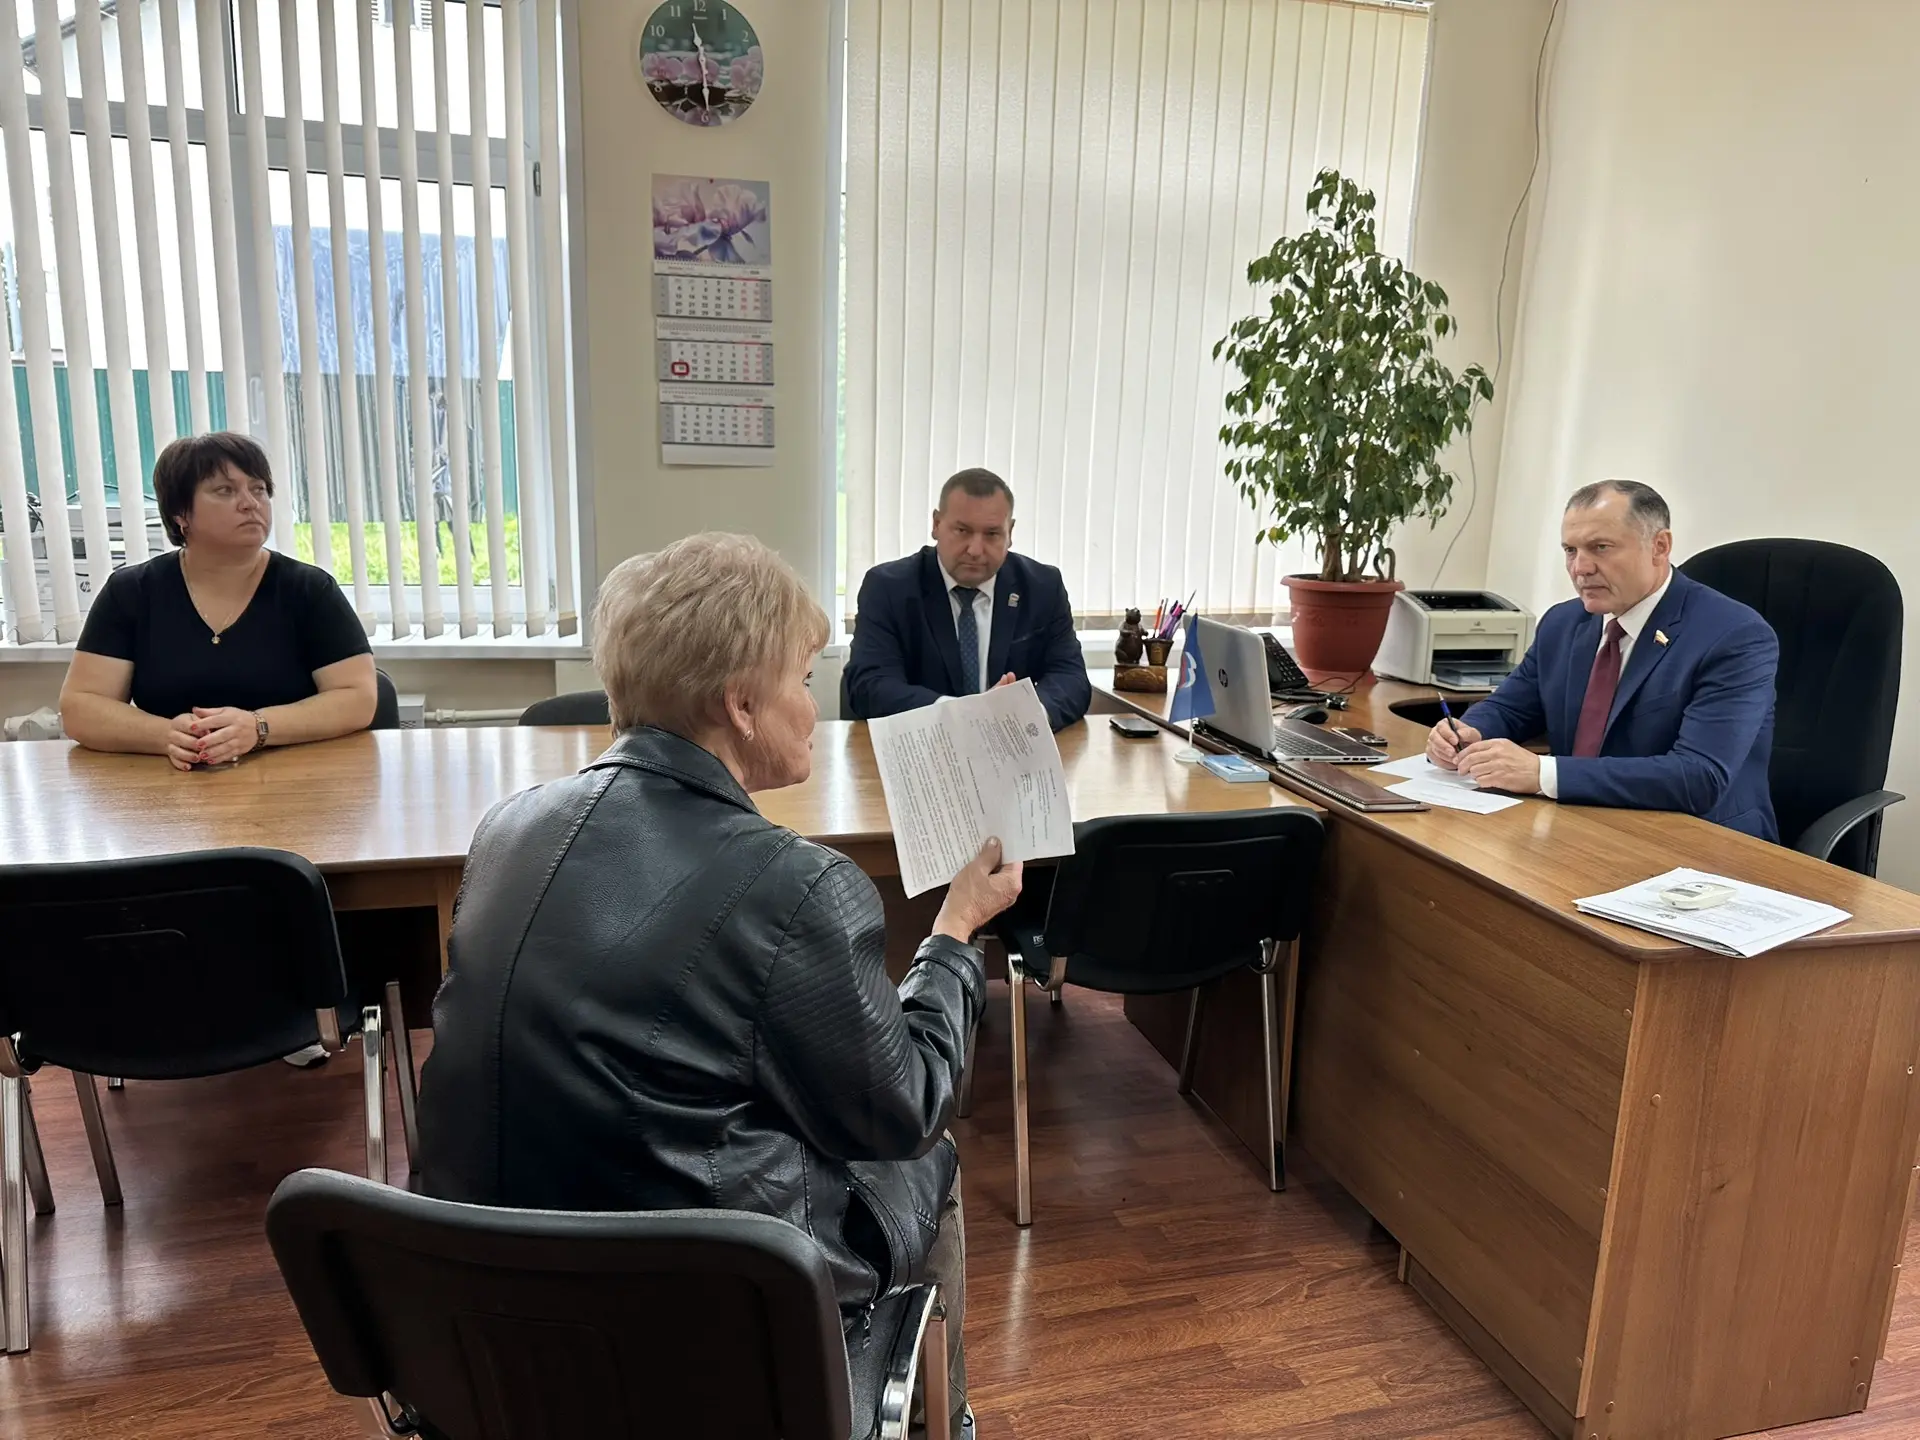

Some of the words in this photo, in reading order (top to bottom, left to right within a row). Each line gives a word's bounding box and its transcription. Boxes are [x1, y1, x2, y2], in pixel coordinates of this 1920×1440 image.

[670, 5, 681, 17] 11
[692, 0, 707, 12] 12
[722, 8, 727, 20] 1
[650, 24, 665, 37] 10
[742, 31, 749, 42] 2
